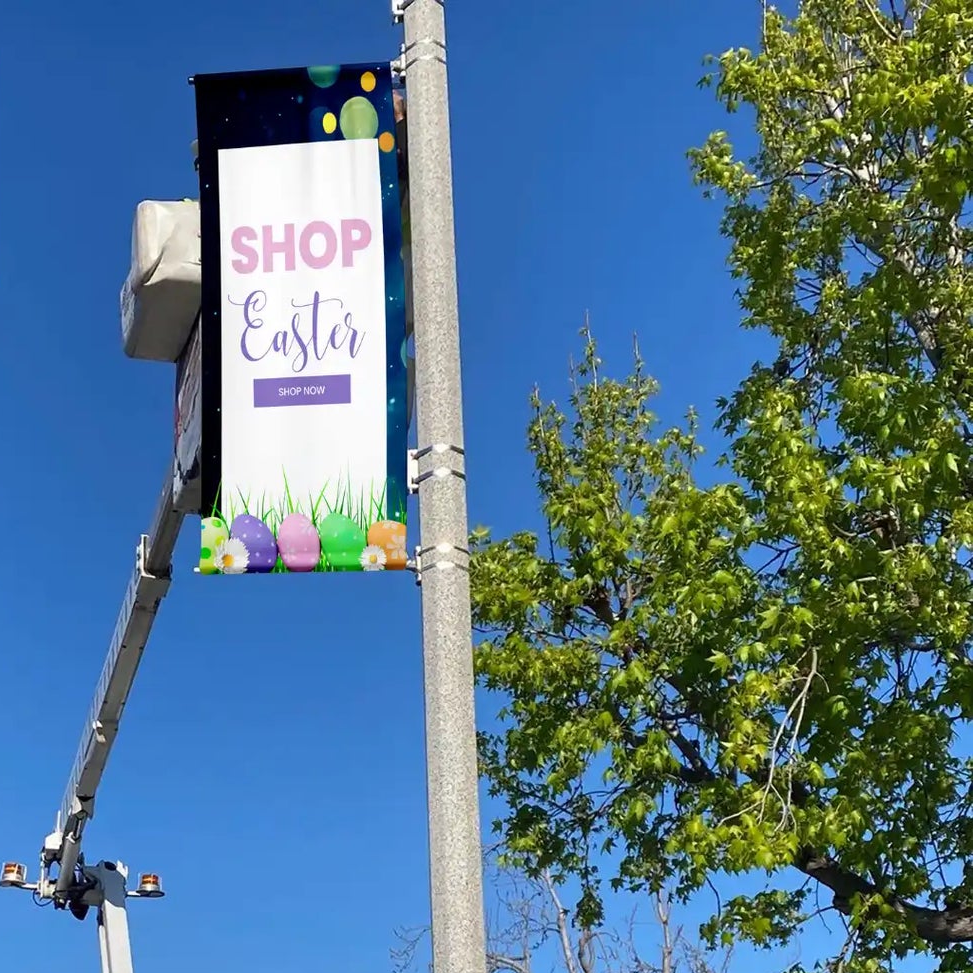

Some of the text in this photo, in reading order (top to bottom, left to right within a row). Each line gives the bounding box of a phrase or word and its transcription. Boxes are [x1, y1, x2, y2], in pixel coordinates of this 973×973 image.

[230, 218, 372, 275] SHOP
[227, 289, 366, 372] Easter
[278, 385, 326, 397] SHOP NOW
